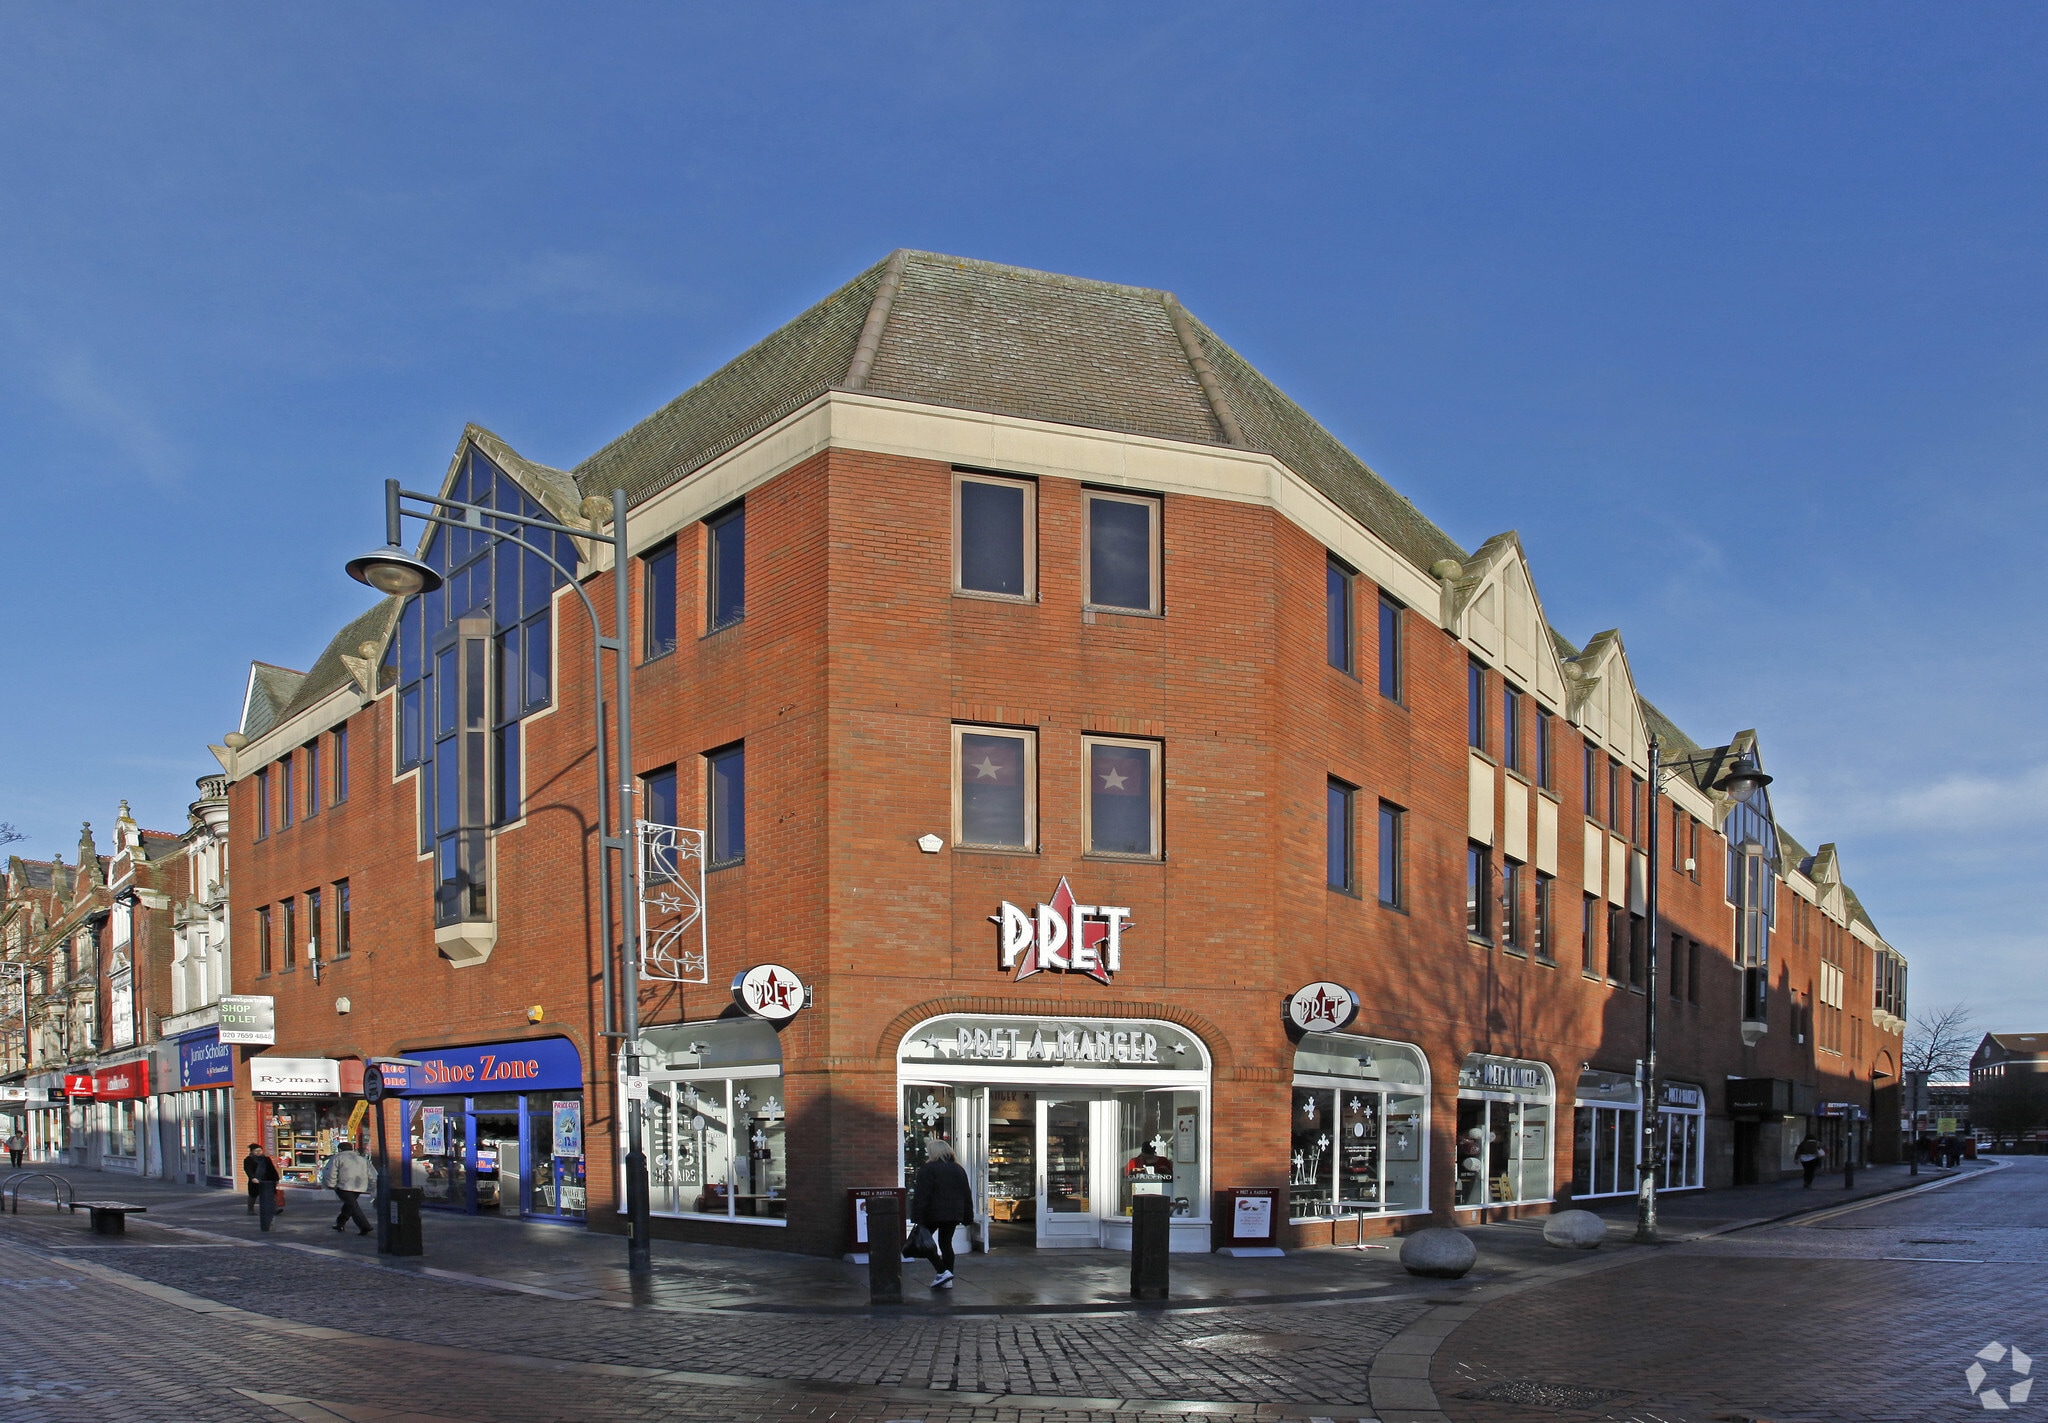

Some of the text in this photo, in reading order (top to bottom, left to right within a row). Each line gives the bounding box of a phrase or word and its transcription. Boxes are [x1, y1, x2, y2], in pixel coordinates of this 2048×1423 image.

[1001, 900, 1131, 971] PRET
[752, 979, 794, 1006] PRET
[222, 1004, 251, 1013] SHOP
[222, 1015, 258, 1023] TO LET
[1300, 996, 1342, 1019] PRET
[190, 1043, 229, 1066] Junior Scholars
[956, 1027, 1158, 1061] PRET A MANGER
[380, 1063, 406, 1073] hoe
[424, 1055, 539, 1084] Shoe Zone
[383, 1077, 407, 1086] one
[656, 1169, 697, 1183] UPSAIRS
